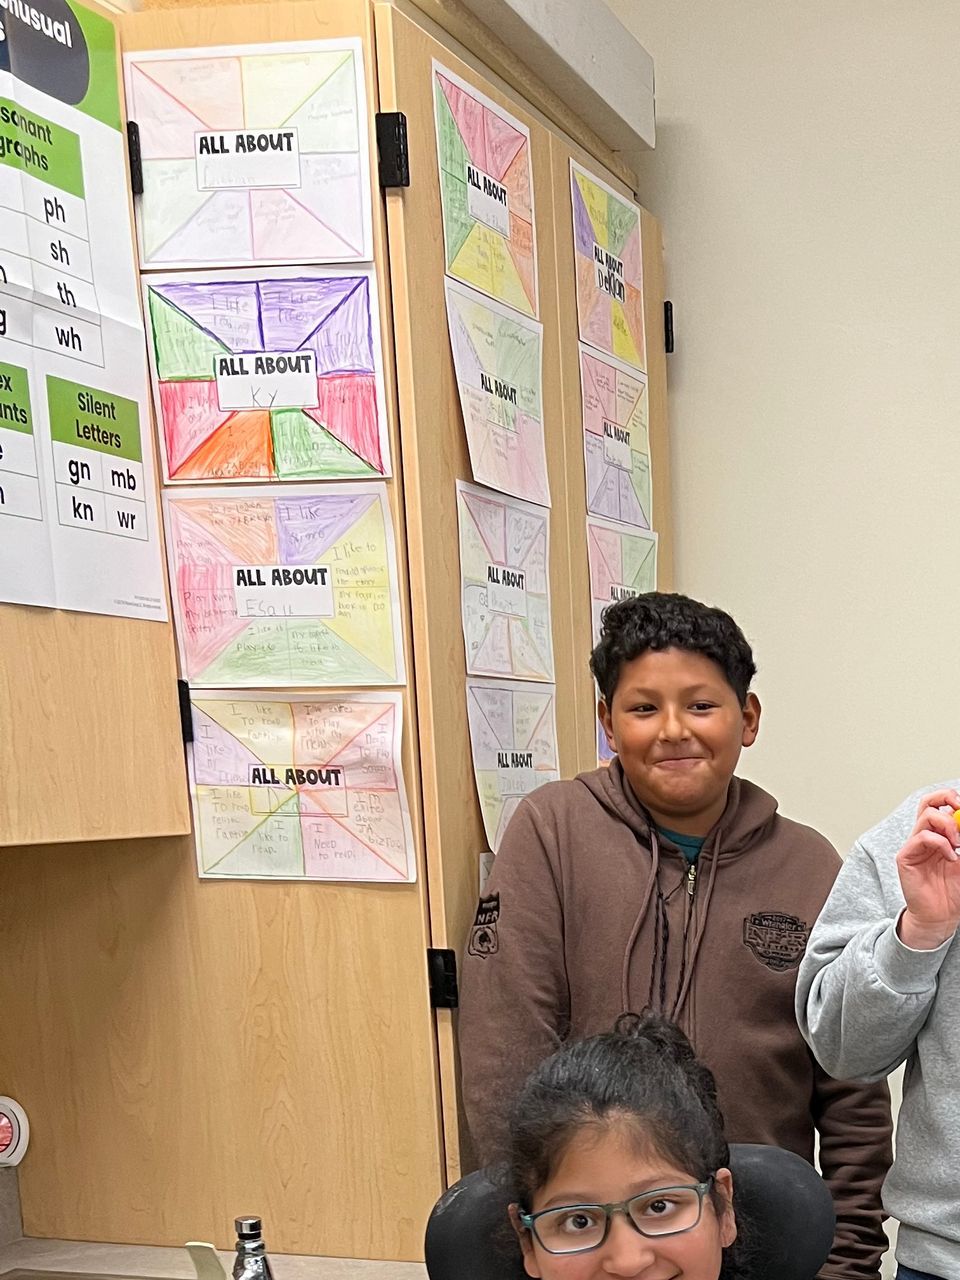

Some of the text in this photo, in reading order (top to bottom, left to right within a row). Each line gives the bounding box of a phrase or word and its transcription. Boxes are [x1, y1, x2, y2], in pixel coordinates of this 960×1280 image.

[199, 132, 294, 154] ALL ABOUT
[467, 166, 507, 207] ALL ABOUT
[43, 197, 66, 223] ph
[50, 240, 70, 266] sh
[57, 281, 77, 308] th
[55, 326, 82, 351] wh
[219, 354, 311, 376] ALL ABOUT
[480, 373, 517, 406] ALL ABOUT
[78, 392, 116, 420] Silent
[76, 419, 121, 449] Letters
[603, 421, 630, 447] ALL ABOUT
[68, 459, 136, 491] gn mb
[72, 496, 136, 530] kn wr
[236, 568, 327, 586] ALL ABOUT
[487, 566, 524, 591] ALL ABOUT
[497, 752, 533, 769] ALL ABOUT
[252, 768, 341, 786] ALL ABOUT
[477, 910, 499, 924] NFR
[761, 917, 796, 932] Wrangler
